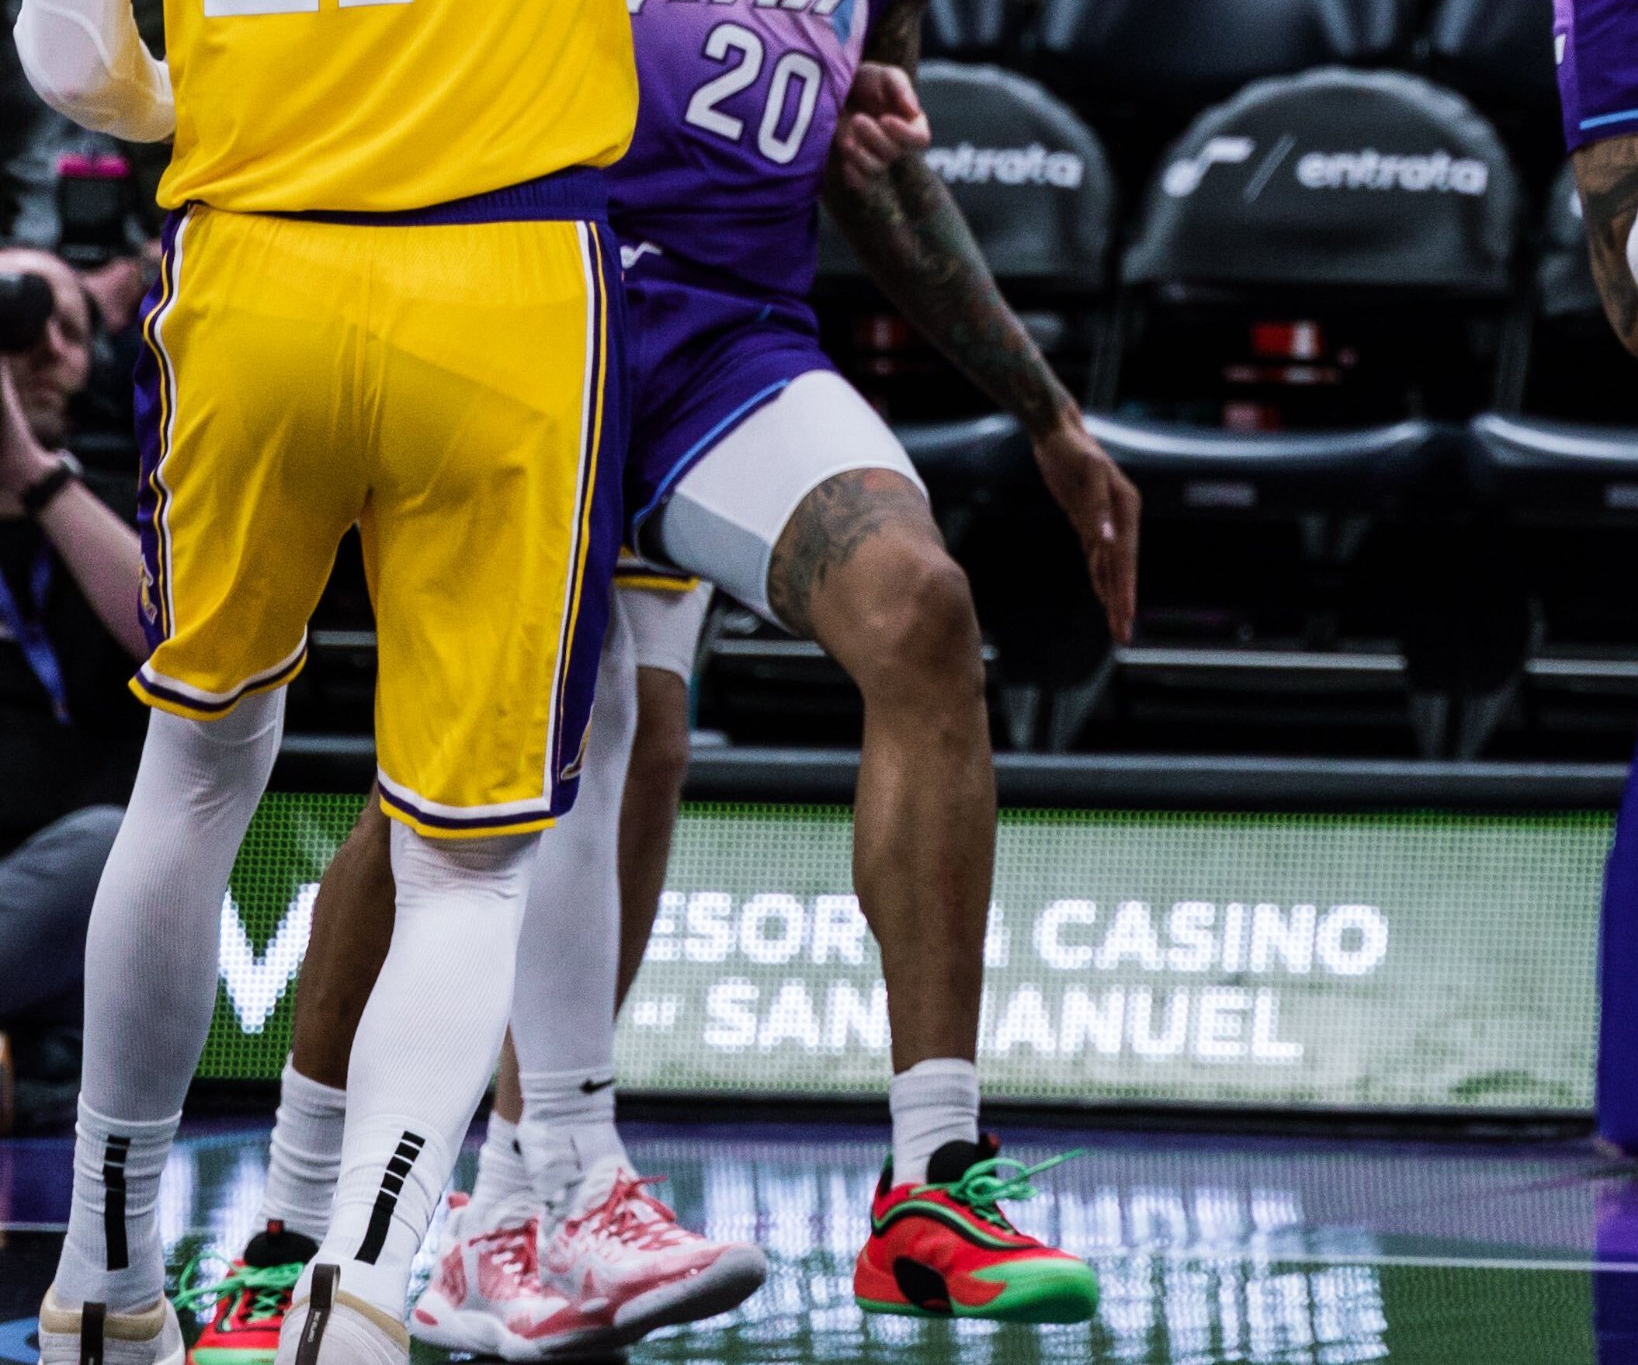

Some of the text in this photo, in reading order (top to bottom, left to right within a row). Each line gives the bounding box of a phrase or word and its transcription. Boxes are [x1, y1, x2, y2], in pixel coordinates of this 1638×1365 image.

[683, 20, 824, 166] 20
[924, 141, 1084, 190] ntrata
[1296, 146, 1491, 199] entrata
[642, 890, 868, 966] ESOR
[1032, 899, 1390, 975] CASINO
[701, 975, 893, 1056] SAN
